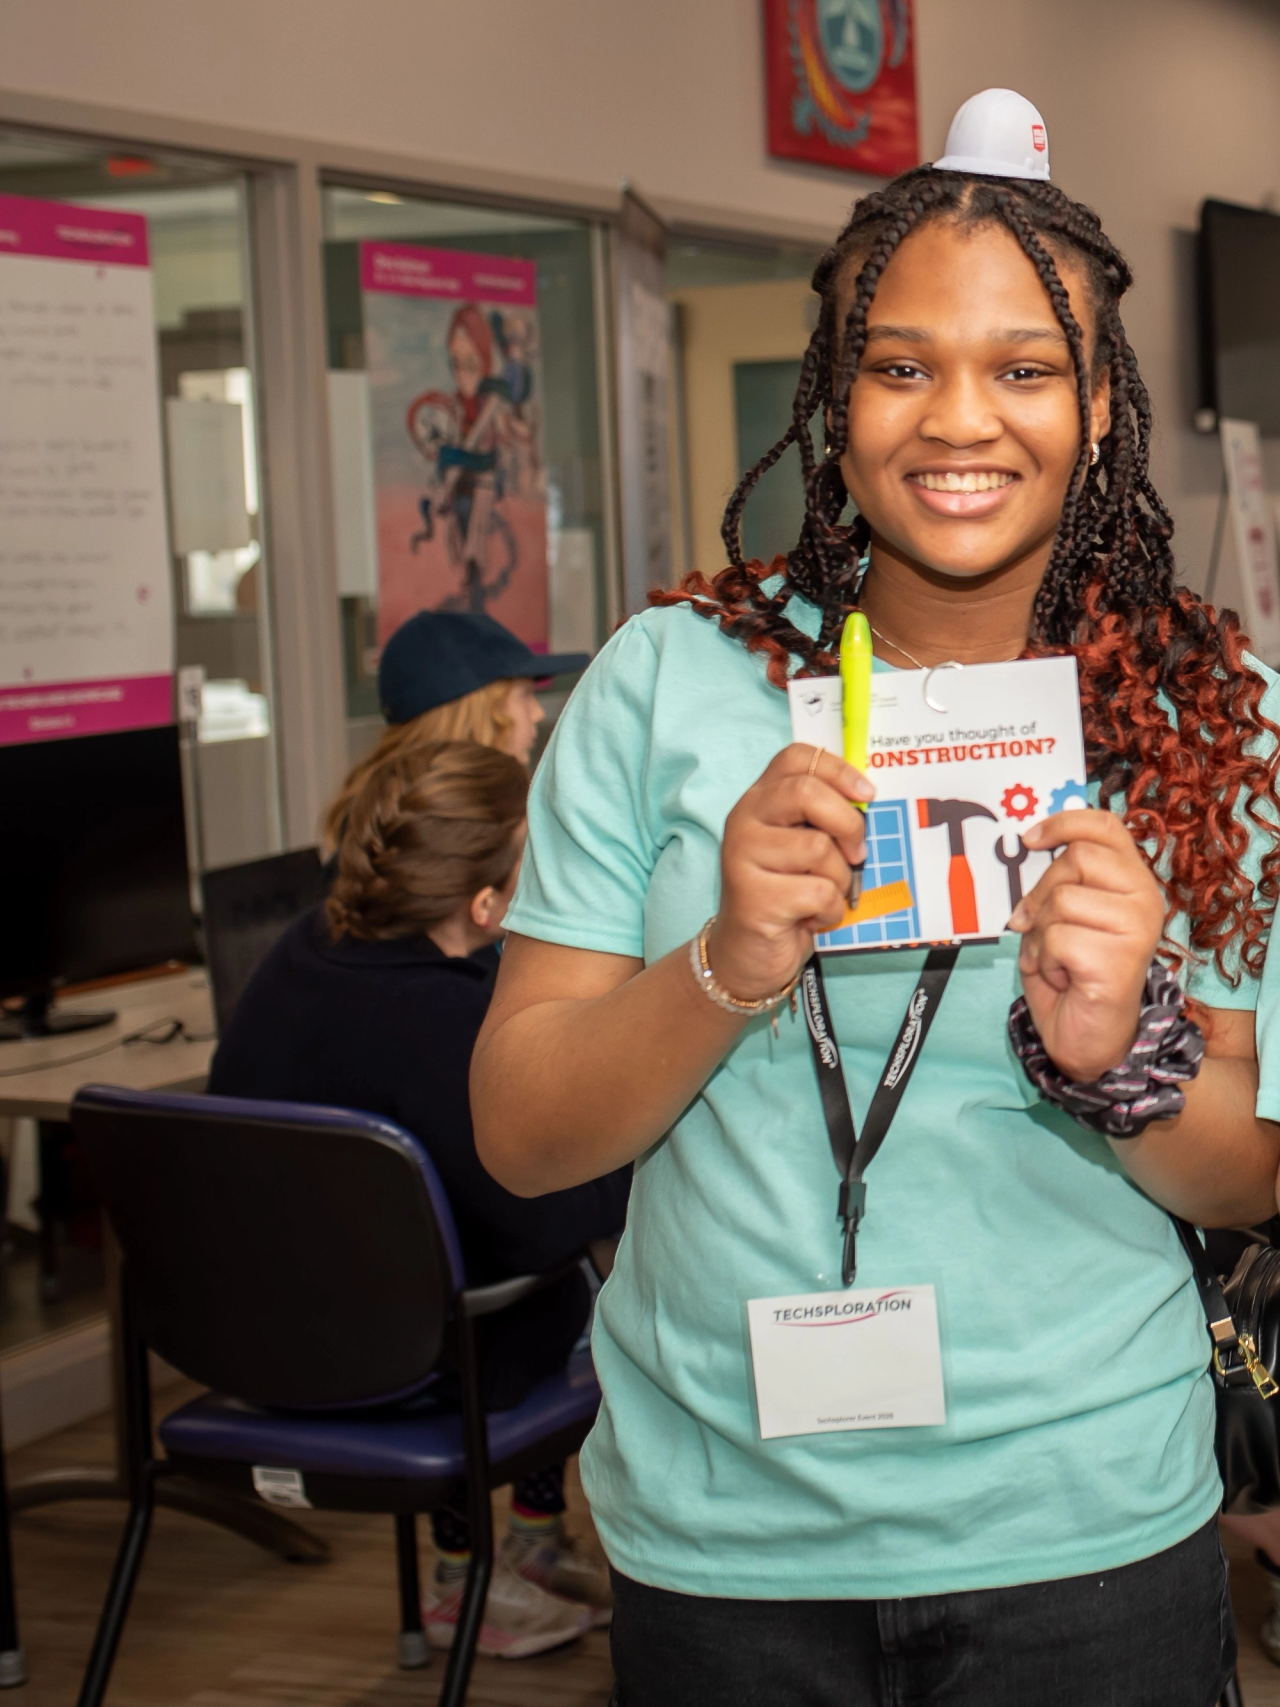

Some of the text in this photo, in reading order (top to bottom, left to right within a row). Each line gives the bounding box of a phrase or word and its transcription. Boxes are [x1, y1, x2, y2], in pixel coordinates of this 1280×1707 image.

[870, 721, 1037, 748] Have you thought of
[866, 737, 1057, 768] ONSTRUCTION?
[772, 1299, 912, 1322] TECHSPLORATION
